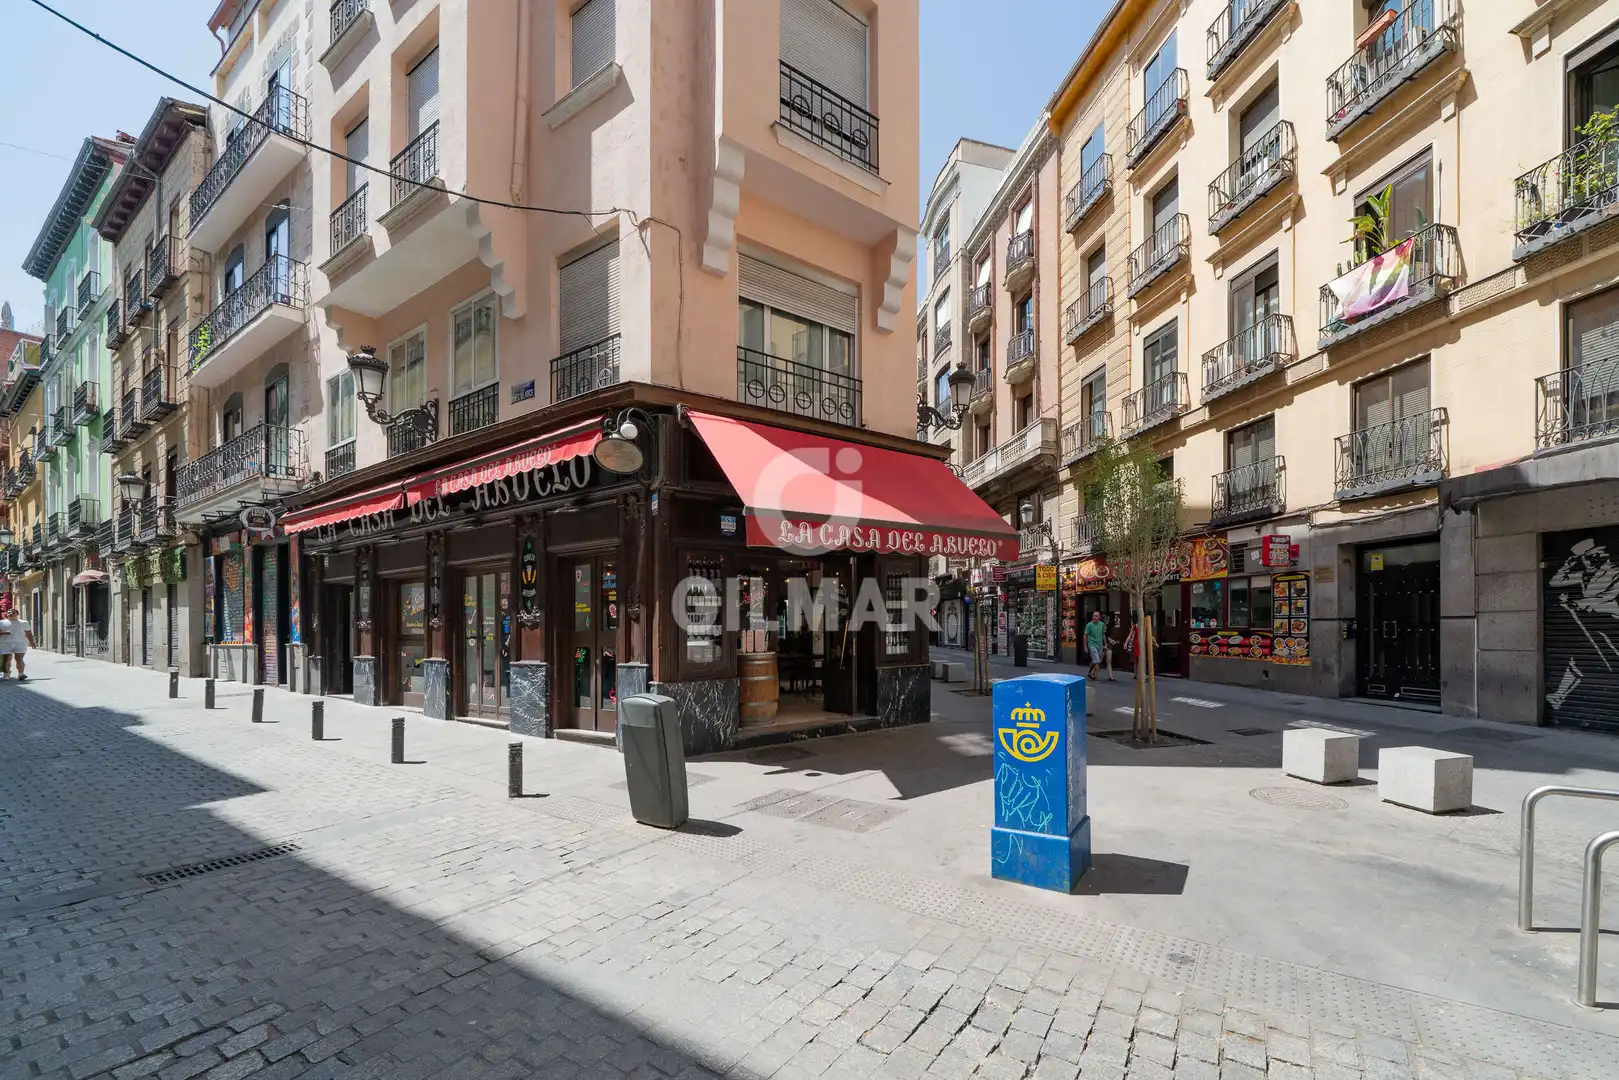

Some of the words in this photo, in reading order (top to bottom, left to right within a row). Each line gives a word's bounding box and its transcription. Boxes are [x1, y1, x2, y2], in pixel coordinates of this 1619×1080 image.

[504, 446, 551, 476] ABUELO
[348, 509, 395, 537] CASA
[778, 520, 813, 544] LA
[819, 523, 880, 549] CASA
[886, 530, 926, 551] DEL
[929, 533, 997, 557] ABUELO
